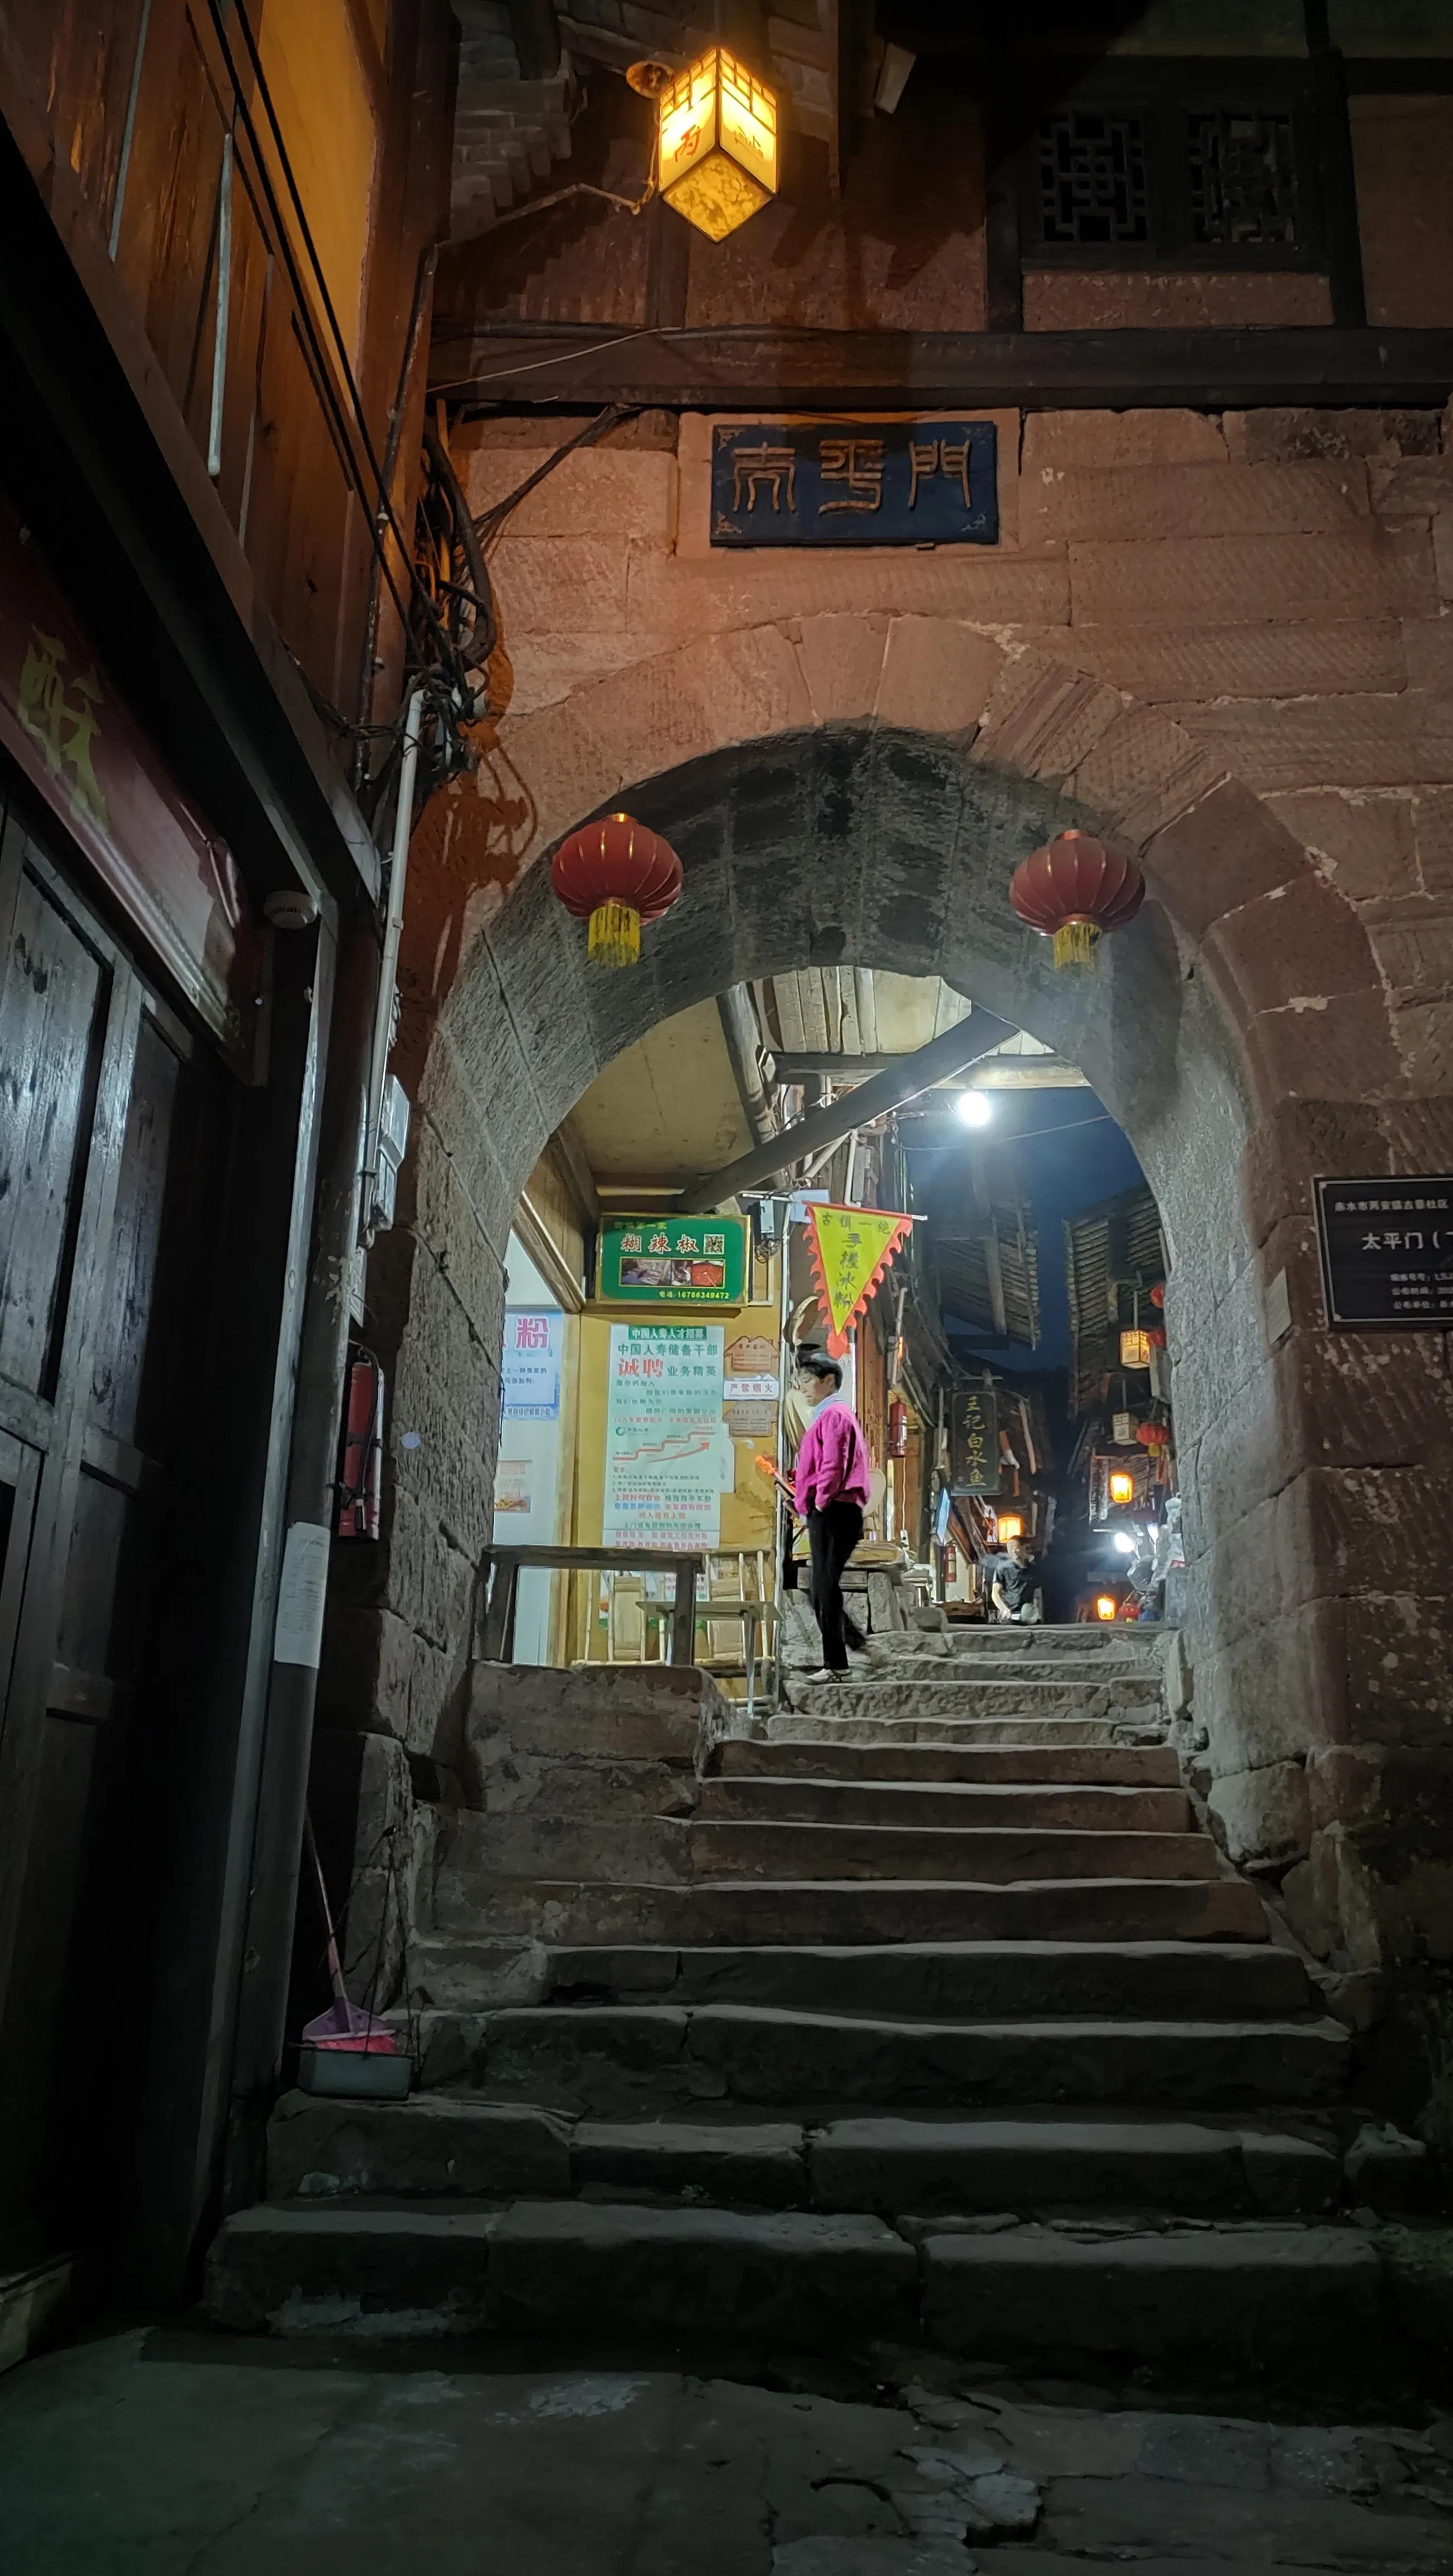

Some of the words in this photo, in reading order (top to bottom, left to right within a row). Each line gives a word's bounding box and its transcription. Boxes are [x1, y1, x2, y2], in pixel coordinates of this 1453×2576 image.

[1362, 1230, 1453, 1251] 太平门（
[617, 1343, 718, 1357] 中国人寿储备干部
[617, 1358, 664, 1378] 诚聘
[667, 1365, 717, 1377] 业务精英
